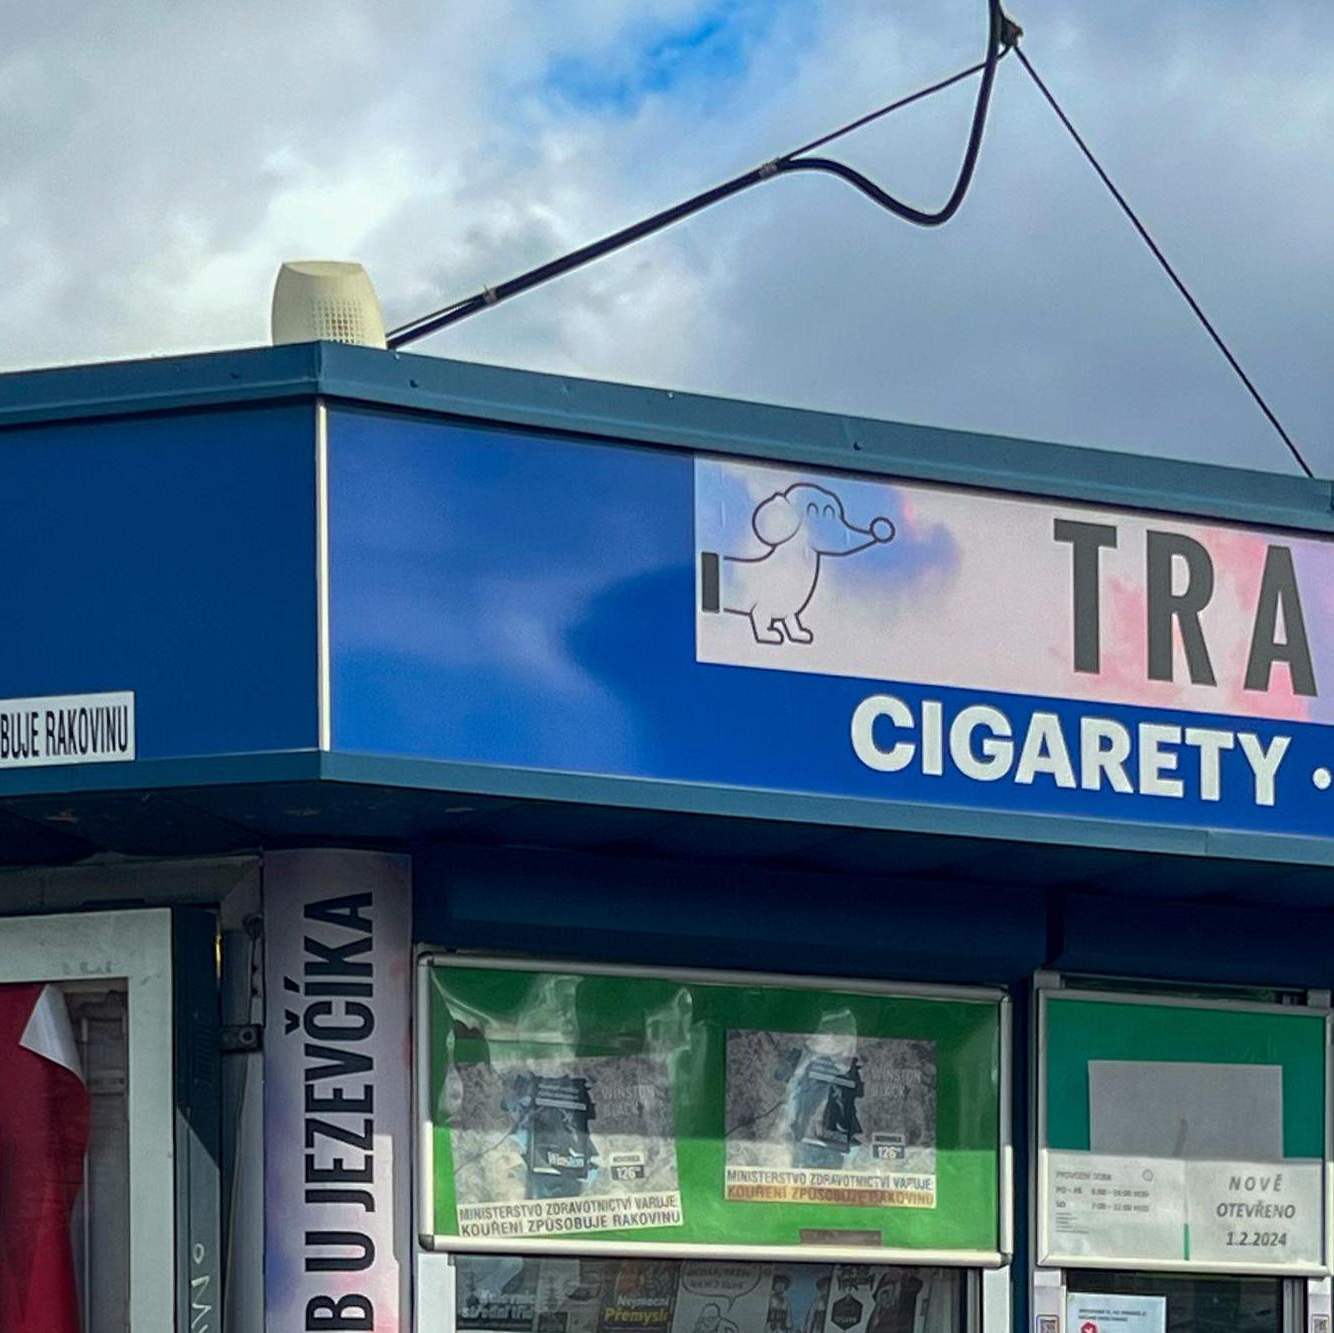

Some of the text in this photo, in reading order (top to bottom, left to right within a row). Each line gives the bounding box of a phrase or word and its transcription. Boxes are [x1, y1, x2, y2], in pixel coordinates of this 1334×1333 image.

[45, 703, 128, 758] RAKOVINU
[850, 692, 1293, 807] CIGARETY
[283, 892, 374, 1215] JEZEVČÍKA
[727, 1183, 788, 1199] KOUŘENÍ
[728, 1169, 807, 1184] MINISTERSTVO
[810, 1172, 891, 1188] ZDRAVOTNICTVÍ
[460, 1205, 543, 1220] MINISTERSTVO
[546, 1197, 632, 1216] ZDRAVOTNICTVÍ
[1216, 1199, 1297, 1219] OTEVŘENO
[462, 1210, 681, 1237] KOUŘENÍ ZPŮSOBUJE RAKOVINU
[1226, 1231, 1288, 1247] 1.2.2024
[304, 1229, 376, 1275] U
